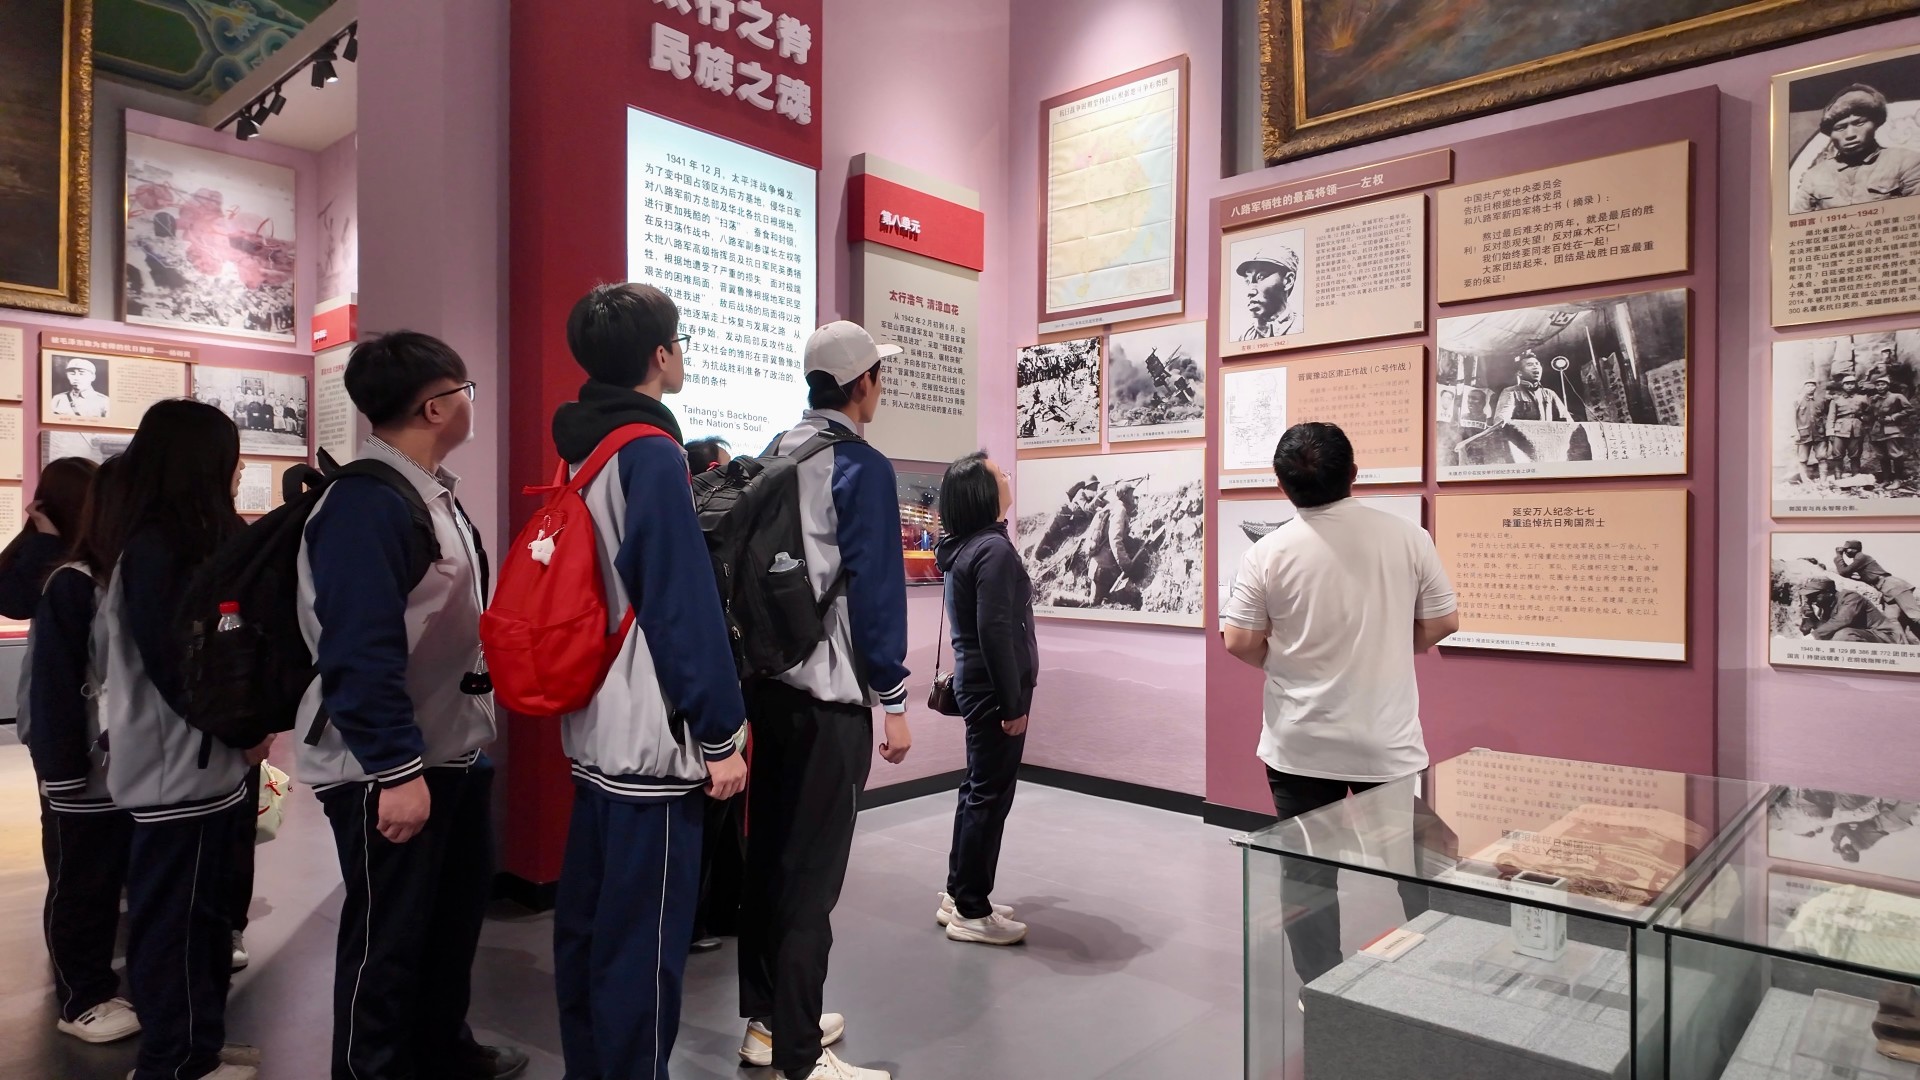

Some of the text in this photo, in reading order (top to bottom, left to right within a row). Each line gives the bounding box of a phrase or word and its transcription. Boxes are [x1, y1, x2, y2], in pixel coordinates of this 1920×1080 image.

[649, 22, 812, 125] 民族之魂
[1230, 173, 1385, 218] 八路军牺牲的最高将领——左权
[1463, 178, 1563, 205] 中国共产党中央委员会
[1463, 189, 1563, 216] 告抗日根据地全体党员
[880, 209, 921, 234] 第八单元
[1482, 204, 1655, 242] 熬过最后难关的两年，就是最后的胜
[1482, 237, 1610, 264] 我们始终要同老百姓在一起！
[1482, 240, 1655, 275] 大家团结起来，团结是战胜日寇最重
[889, 289, 959, 316] 太行浩气 清漳血花
[1789, 285, 1920, 306] 2014年被列为民政部公布的第一
[683, 404, 770, 424] Taihang's Backbone,
[689, 416, 703, 426] the
[706, 418, 741, 430] Nation's
[1502, 518, 1605, 528] 隆重追悼抗日殉国烈士
[1512, 506, 1595, 517] 延安万人纪念七七
